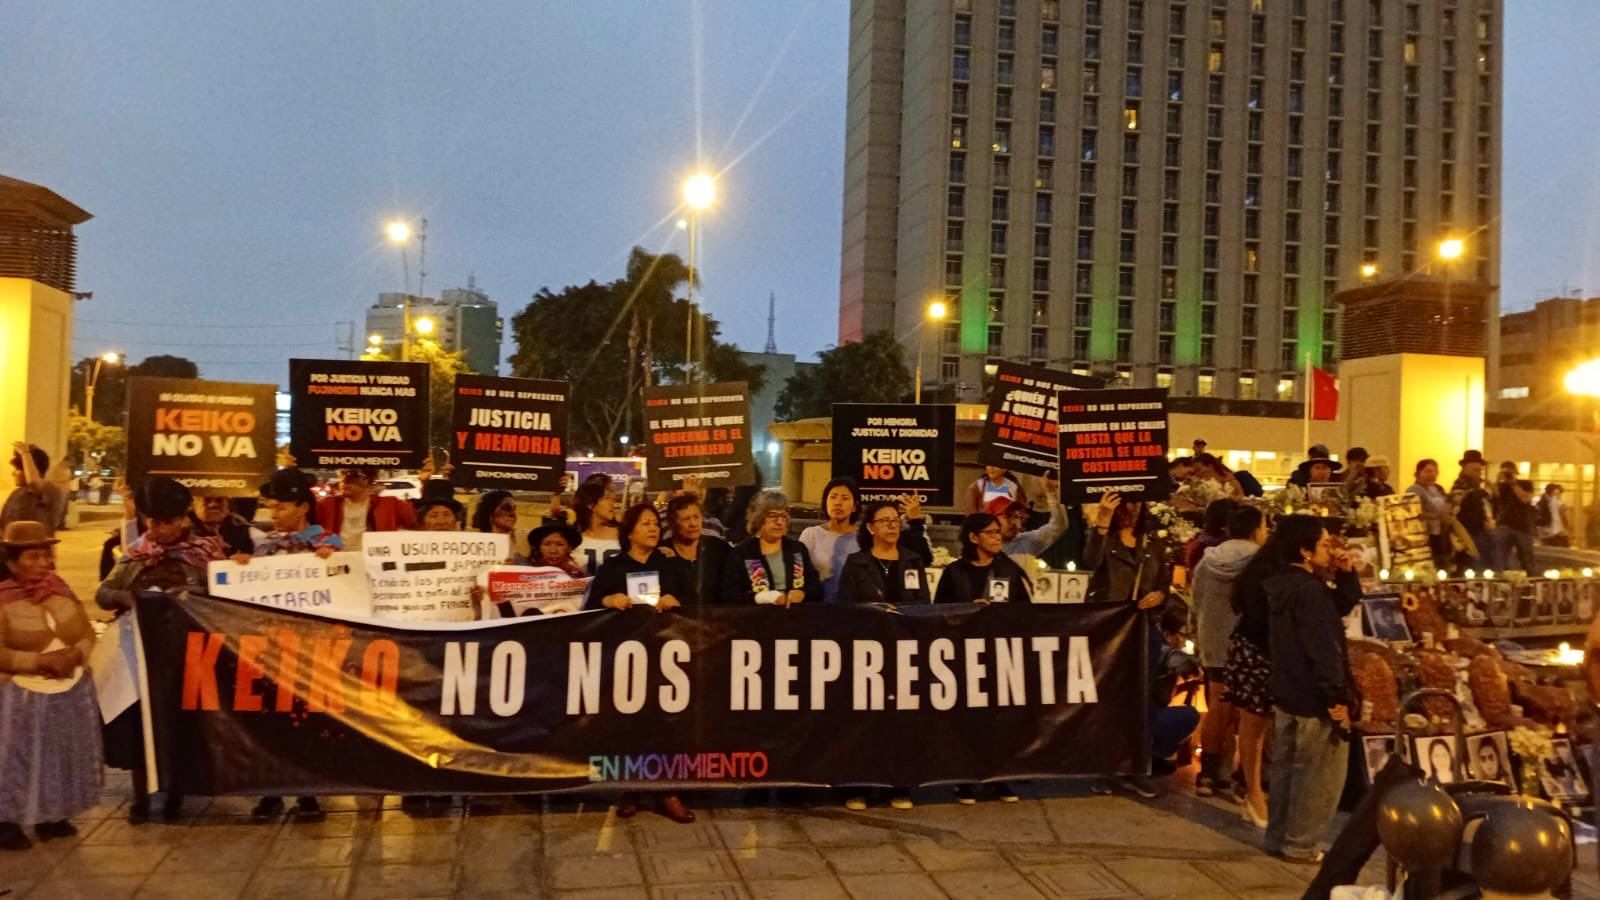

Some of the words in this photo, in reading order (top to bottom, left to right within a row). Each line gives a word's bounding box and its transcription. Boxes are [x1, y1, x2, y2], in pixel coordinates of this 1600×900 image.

[310, 374, 328, 383] POR
[329, 374, 367, 384] JUSTICIA
[368, 375, 376, 384] Y
[376, 375, 410, 385] VERDAD
[360, 386, 394, 396] NUNCA
[485, 389, 497, 397] NO
[517, 391, 565, 402] REPRESENTA
[1086, 404, 1098, 412] NO
[155, 408, 256, 433] KEIKO
[325, 407, 398, 425] KEIKO
[468, 408, 552, 431] JUSTICIA
[649, 420, 660, 429] EL
[686, 418, 699, 427] NO
[701, 417, 712, 426] TE
[867, 418, 882, 426] POR
[884, 418, 918, 426] MEMORIA
[851, 428, 889, 437] JUSTICIA
[891, 429, 898, 437] Y
[899, 429, 939, 438] DIGNIDAD
[1109, 422, 1120, 431] EN
[1121, 421, 1136, 430] LAS
[327, 425, 363, 442] NO
[368, 425, 403, 442] VA
[713, 429, 727, 440] EN
[730, 428, 743, 440] EL
[1075, 432, 1111, 445] HASTA
[1114, 431, 1135, 444] QUE
[1138, 431, 1152, 442] LA
[152, 433, 203, 457] NO
[209, 435, 257, 458] VA
[456, 431, 469, 449] Y
[475, 432, 561, 455] MEMORIA
[664, 443, 734, 458] EXTRANJERO
[862, 448, 926, 464] KEIKO
[1065, 447, 1114, 459] JUSTICIA
[1117, 446, 1130, 457] SE
[1133, 445, 1163, 457] HAGA
[318, 456, 333, 465] EN
[335, 456, 400, 466] MOVIMIENTO
[1082, 459, 1148, 473] COSTUMBRE
[863, 465, 894, 480] NO
[899, 465, 930, 480] VA
[367, 546, 391, 557] UNA
[305, 567, 320, 579] DE
[181, 629, 400, 713] KEIKO
[439, 640, 527, 718] NO
[565, 639, 691, 716] NOS
[730, 635, 1099, 712] REPRESENTA
[589, 754, 621, 782] EN
[626, 751, 768, 781] MOVIMIENTO
